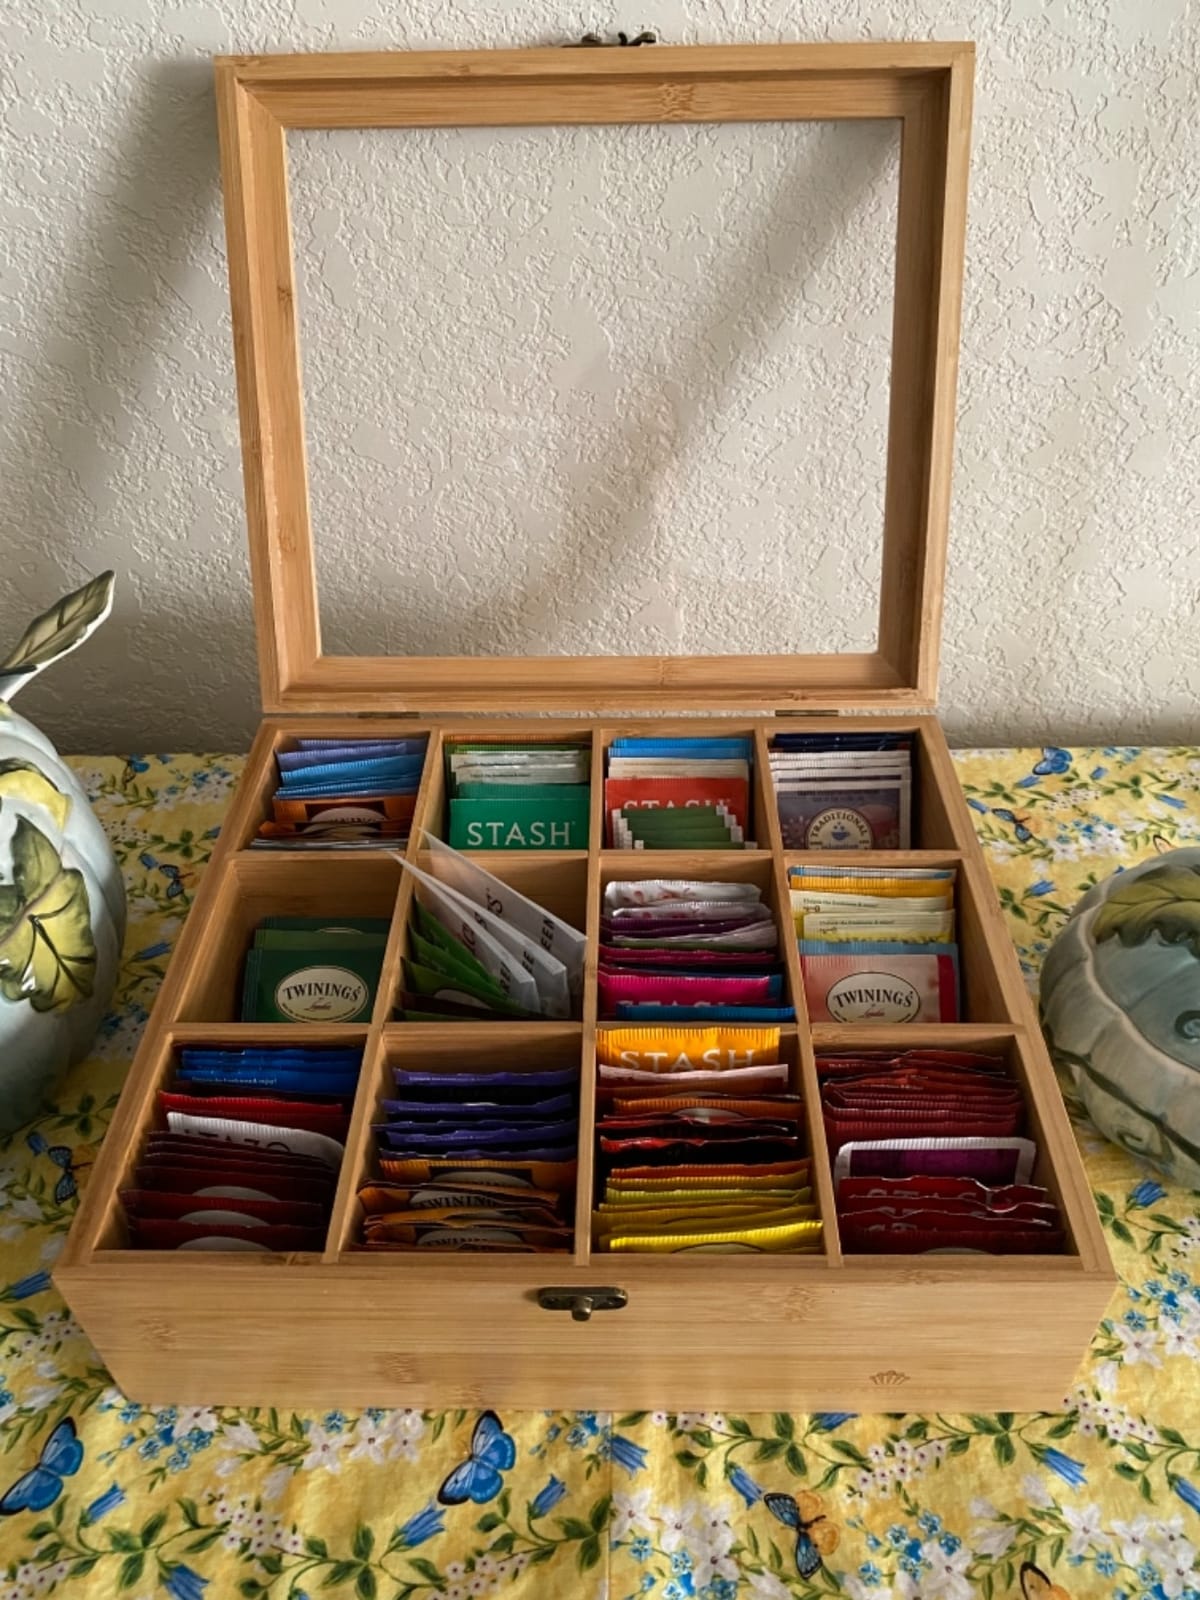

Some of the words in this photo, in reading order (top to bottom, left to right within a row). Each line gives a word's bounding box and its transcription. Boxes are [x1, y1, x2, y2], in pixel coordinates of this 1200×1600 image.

[466, 821, 571, 846] STASH
[810, 810, 869, 838] TRADITIONAL
[282, 982, 362, 1003] TWININGS
[833, 989, 914, 1009] TWININGS
[619, 1049, 755, 1073] STASH
